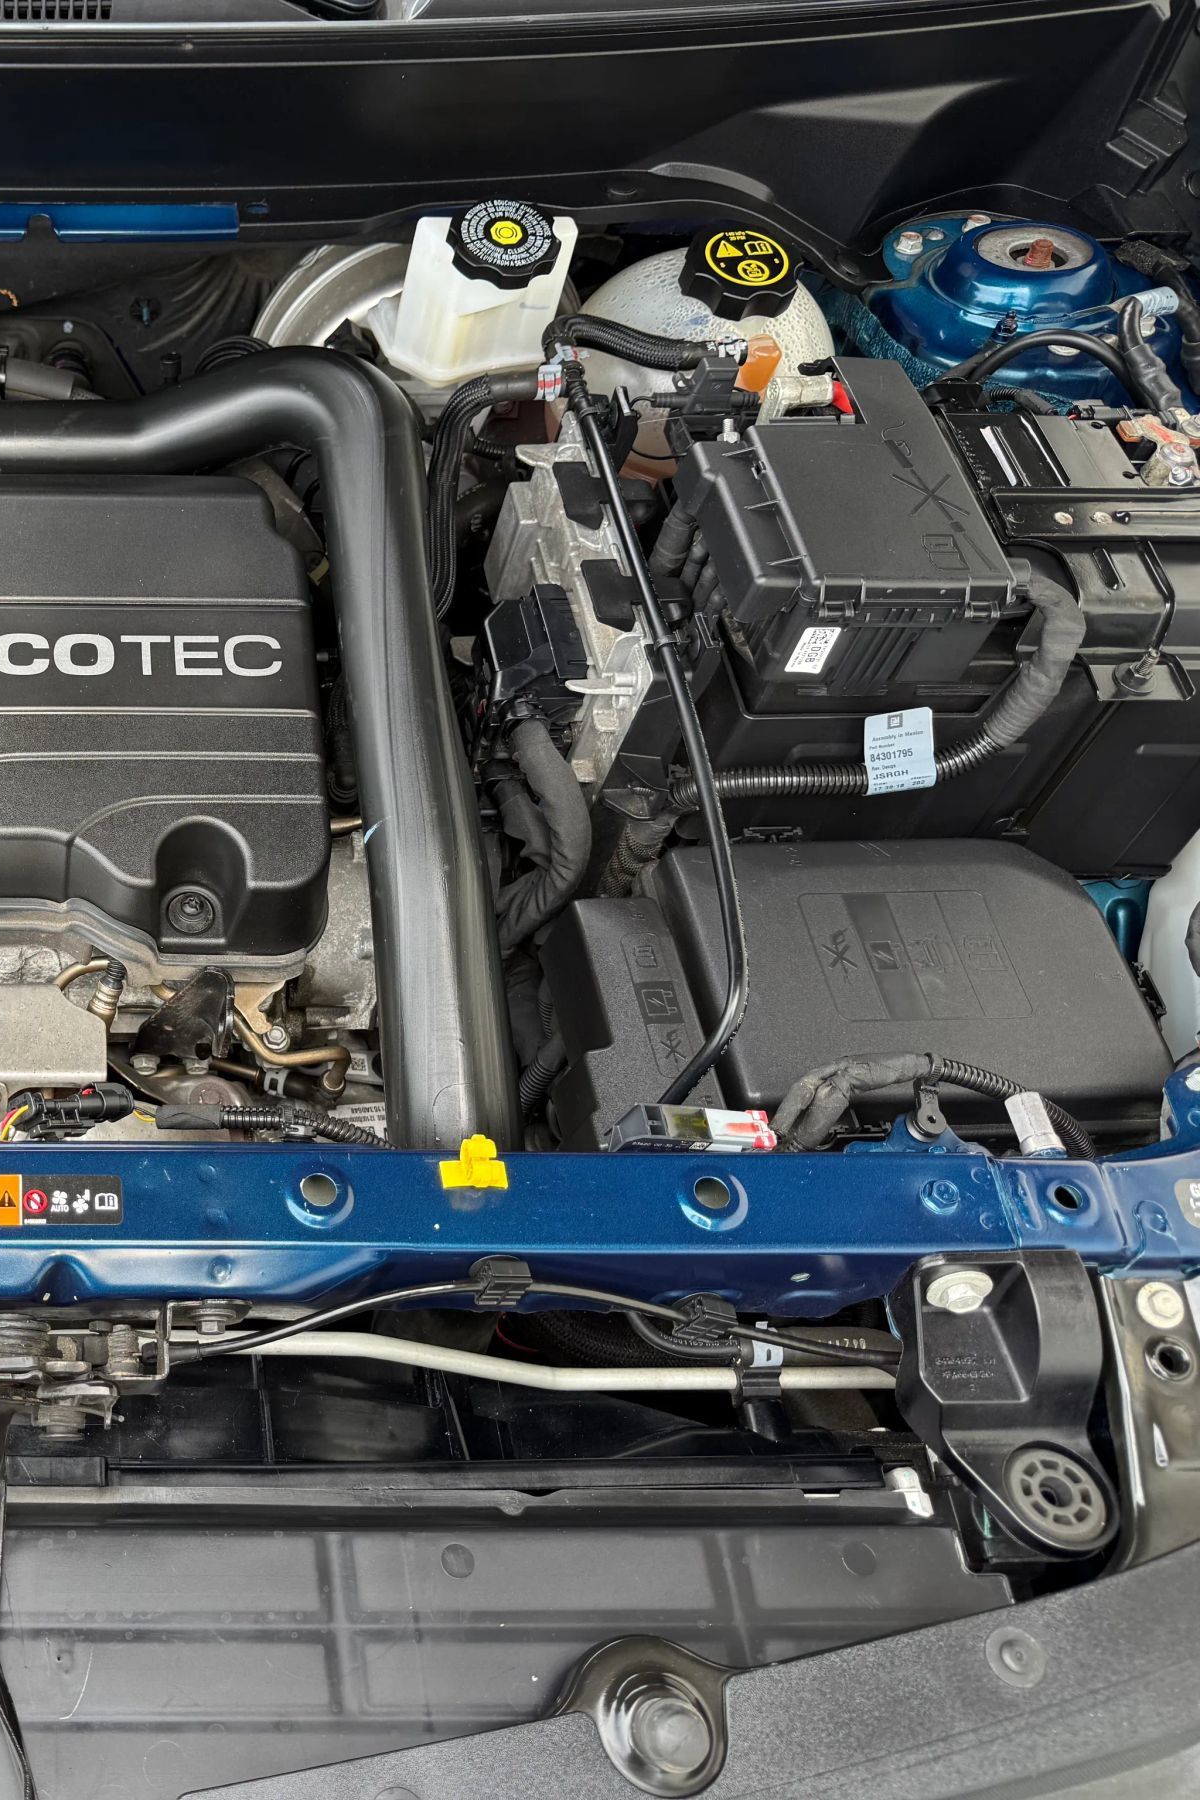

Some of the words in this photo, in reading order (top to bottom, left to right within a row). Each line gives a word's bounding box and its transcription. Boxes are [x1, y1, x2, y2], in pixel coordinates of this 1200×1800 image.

[494, 200, 520, 208] BOUCHON
[870, 748, 914, 762] 84301795
[873, 770, 909, 780] JSRGH
[50, 1204, 70, 1213] AUTO
